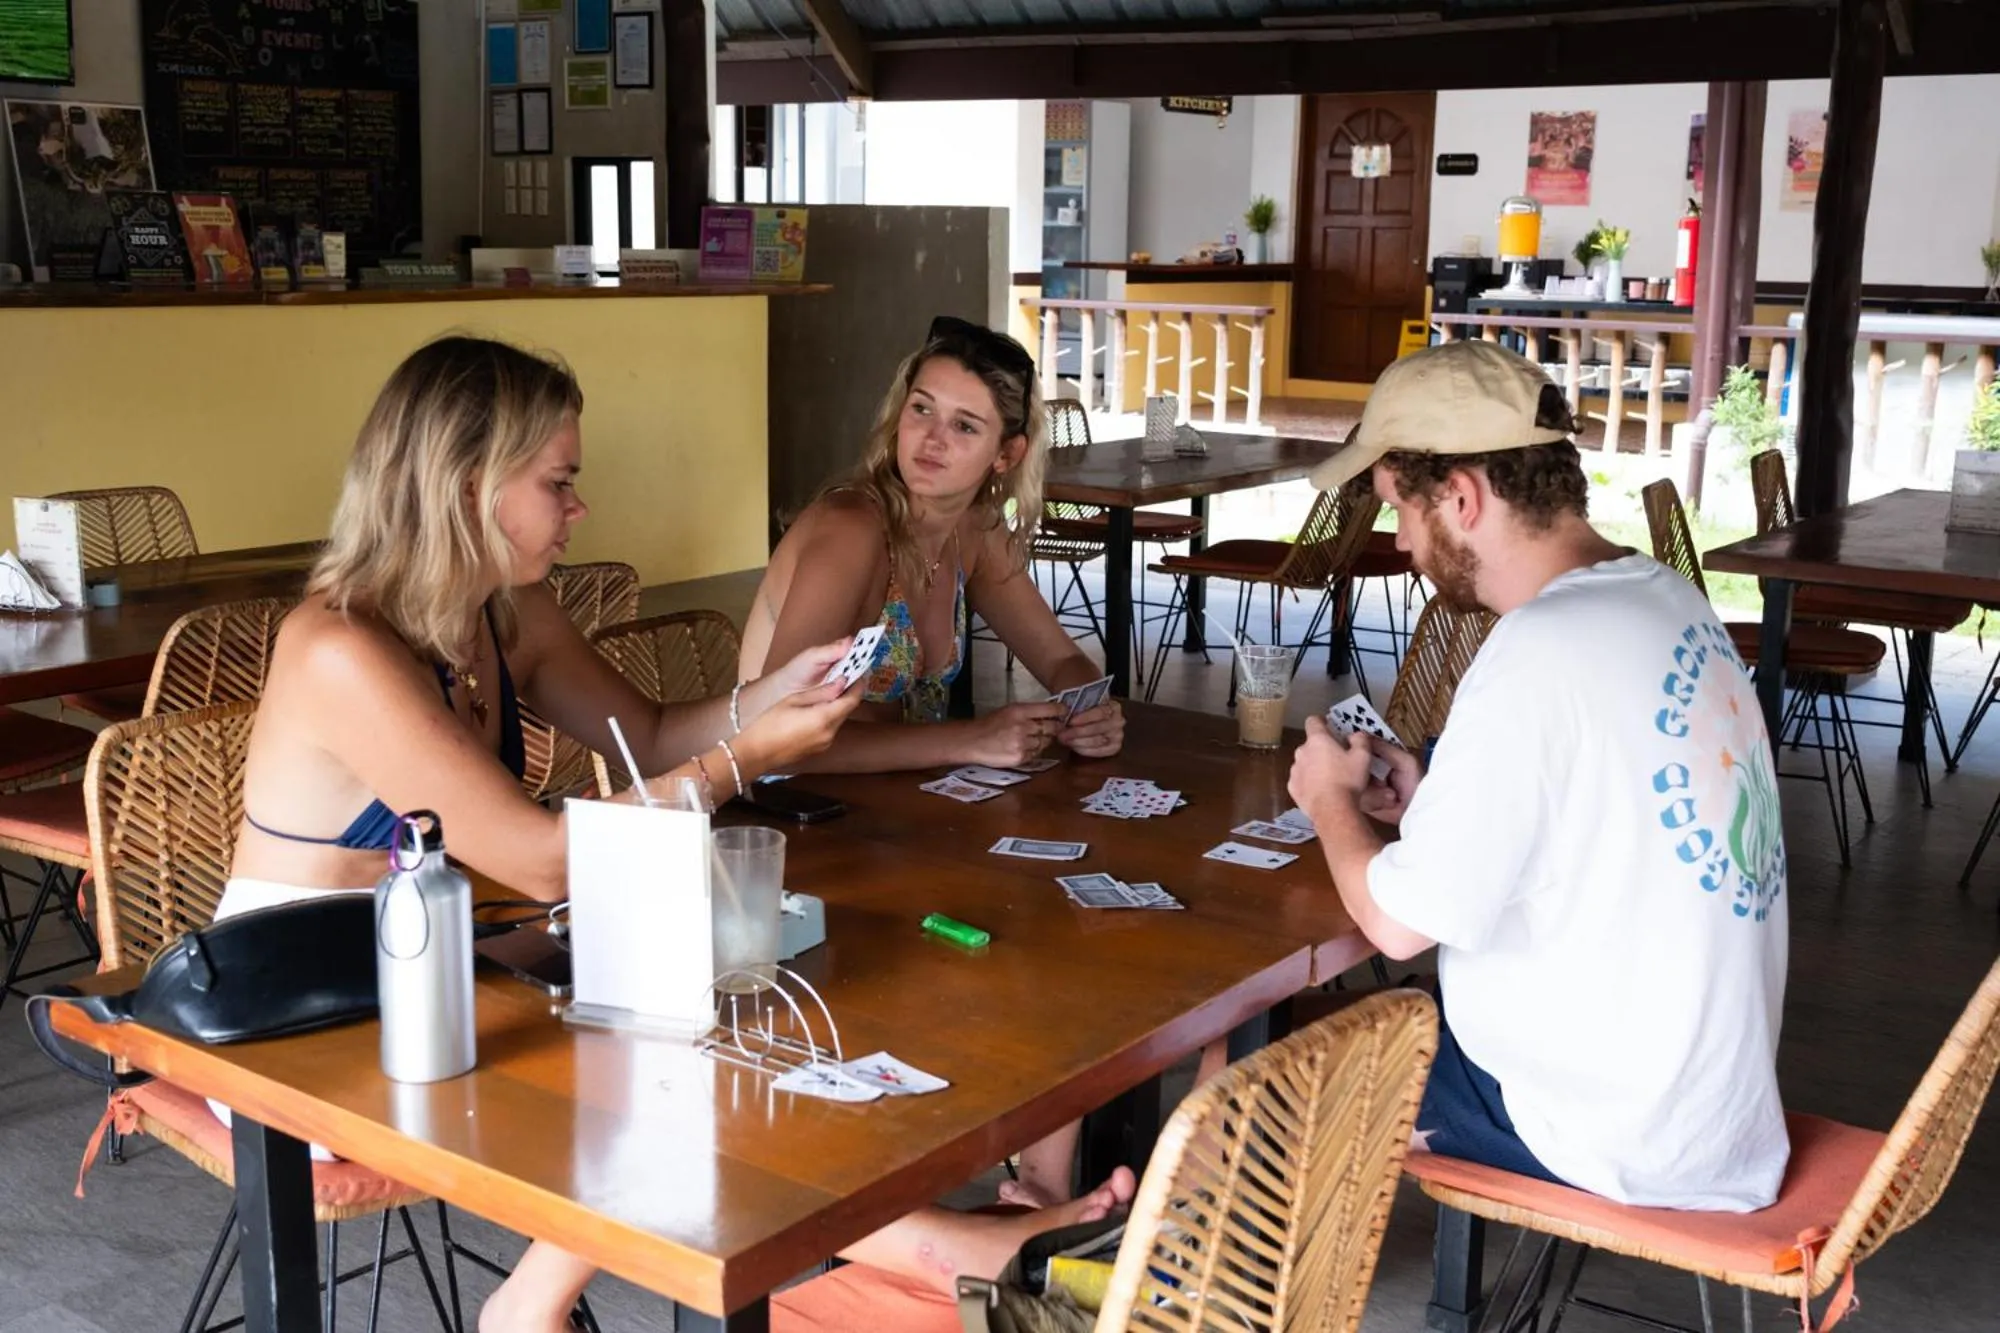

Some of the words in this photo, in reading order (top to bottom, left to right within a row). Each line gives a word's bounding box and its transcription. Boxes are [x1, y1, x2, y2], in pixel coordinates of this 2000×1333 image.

[261, 29, 325, 51] EVENTS
[129, 234, 169, 246] HOUR
[384, 264, 421, 276] TOUR
[422, 264, 457, 276] DESK
